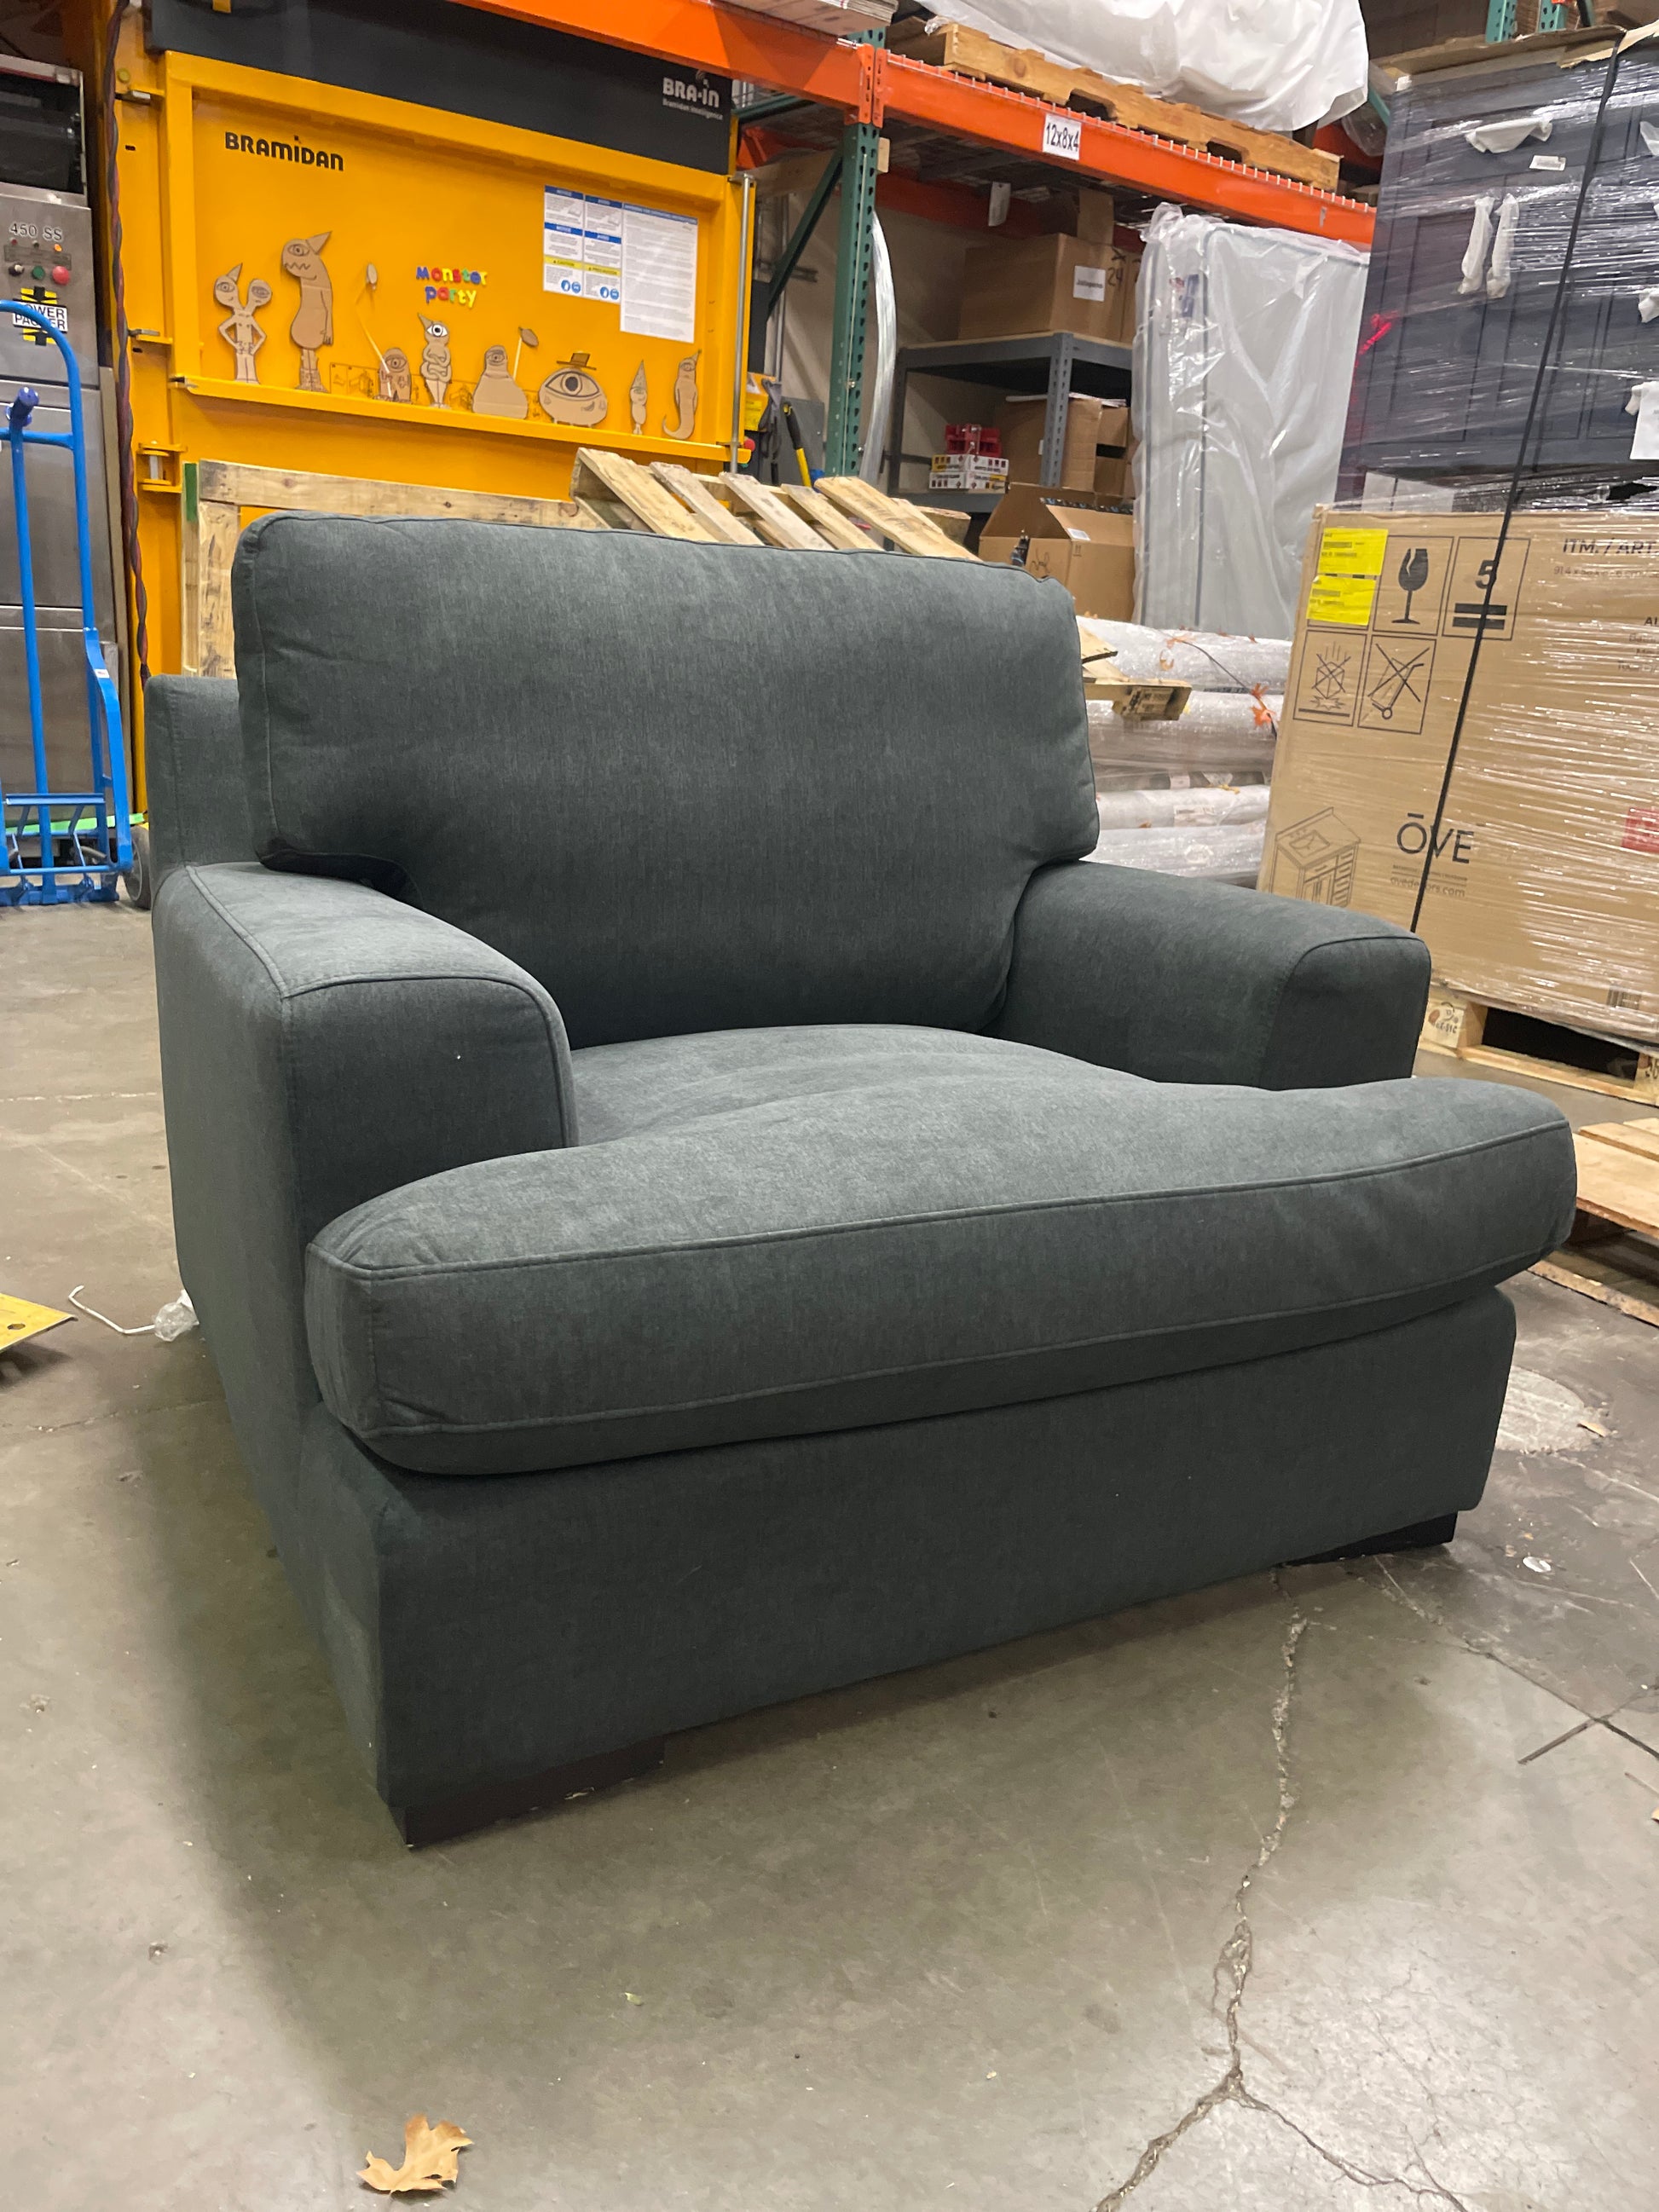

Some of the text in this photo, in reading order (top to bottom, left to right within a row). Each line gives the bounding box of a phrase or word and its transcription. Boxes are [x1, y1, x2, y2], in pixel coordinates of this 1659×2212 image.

[1046, 122, 1079, 152] 12x8x4
[10, 222, 62, 241] 450 SS
[1475, 559, 1496, 589] 5
